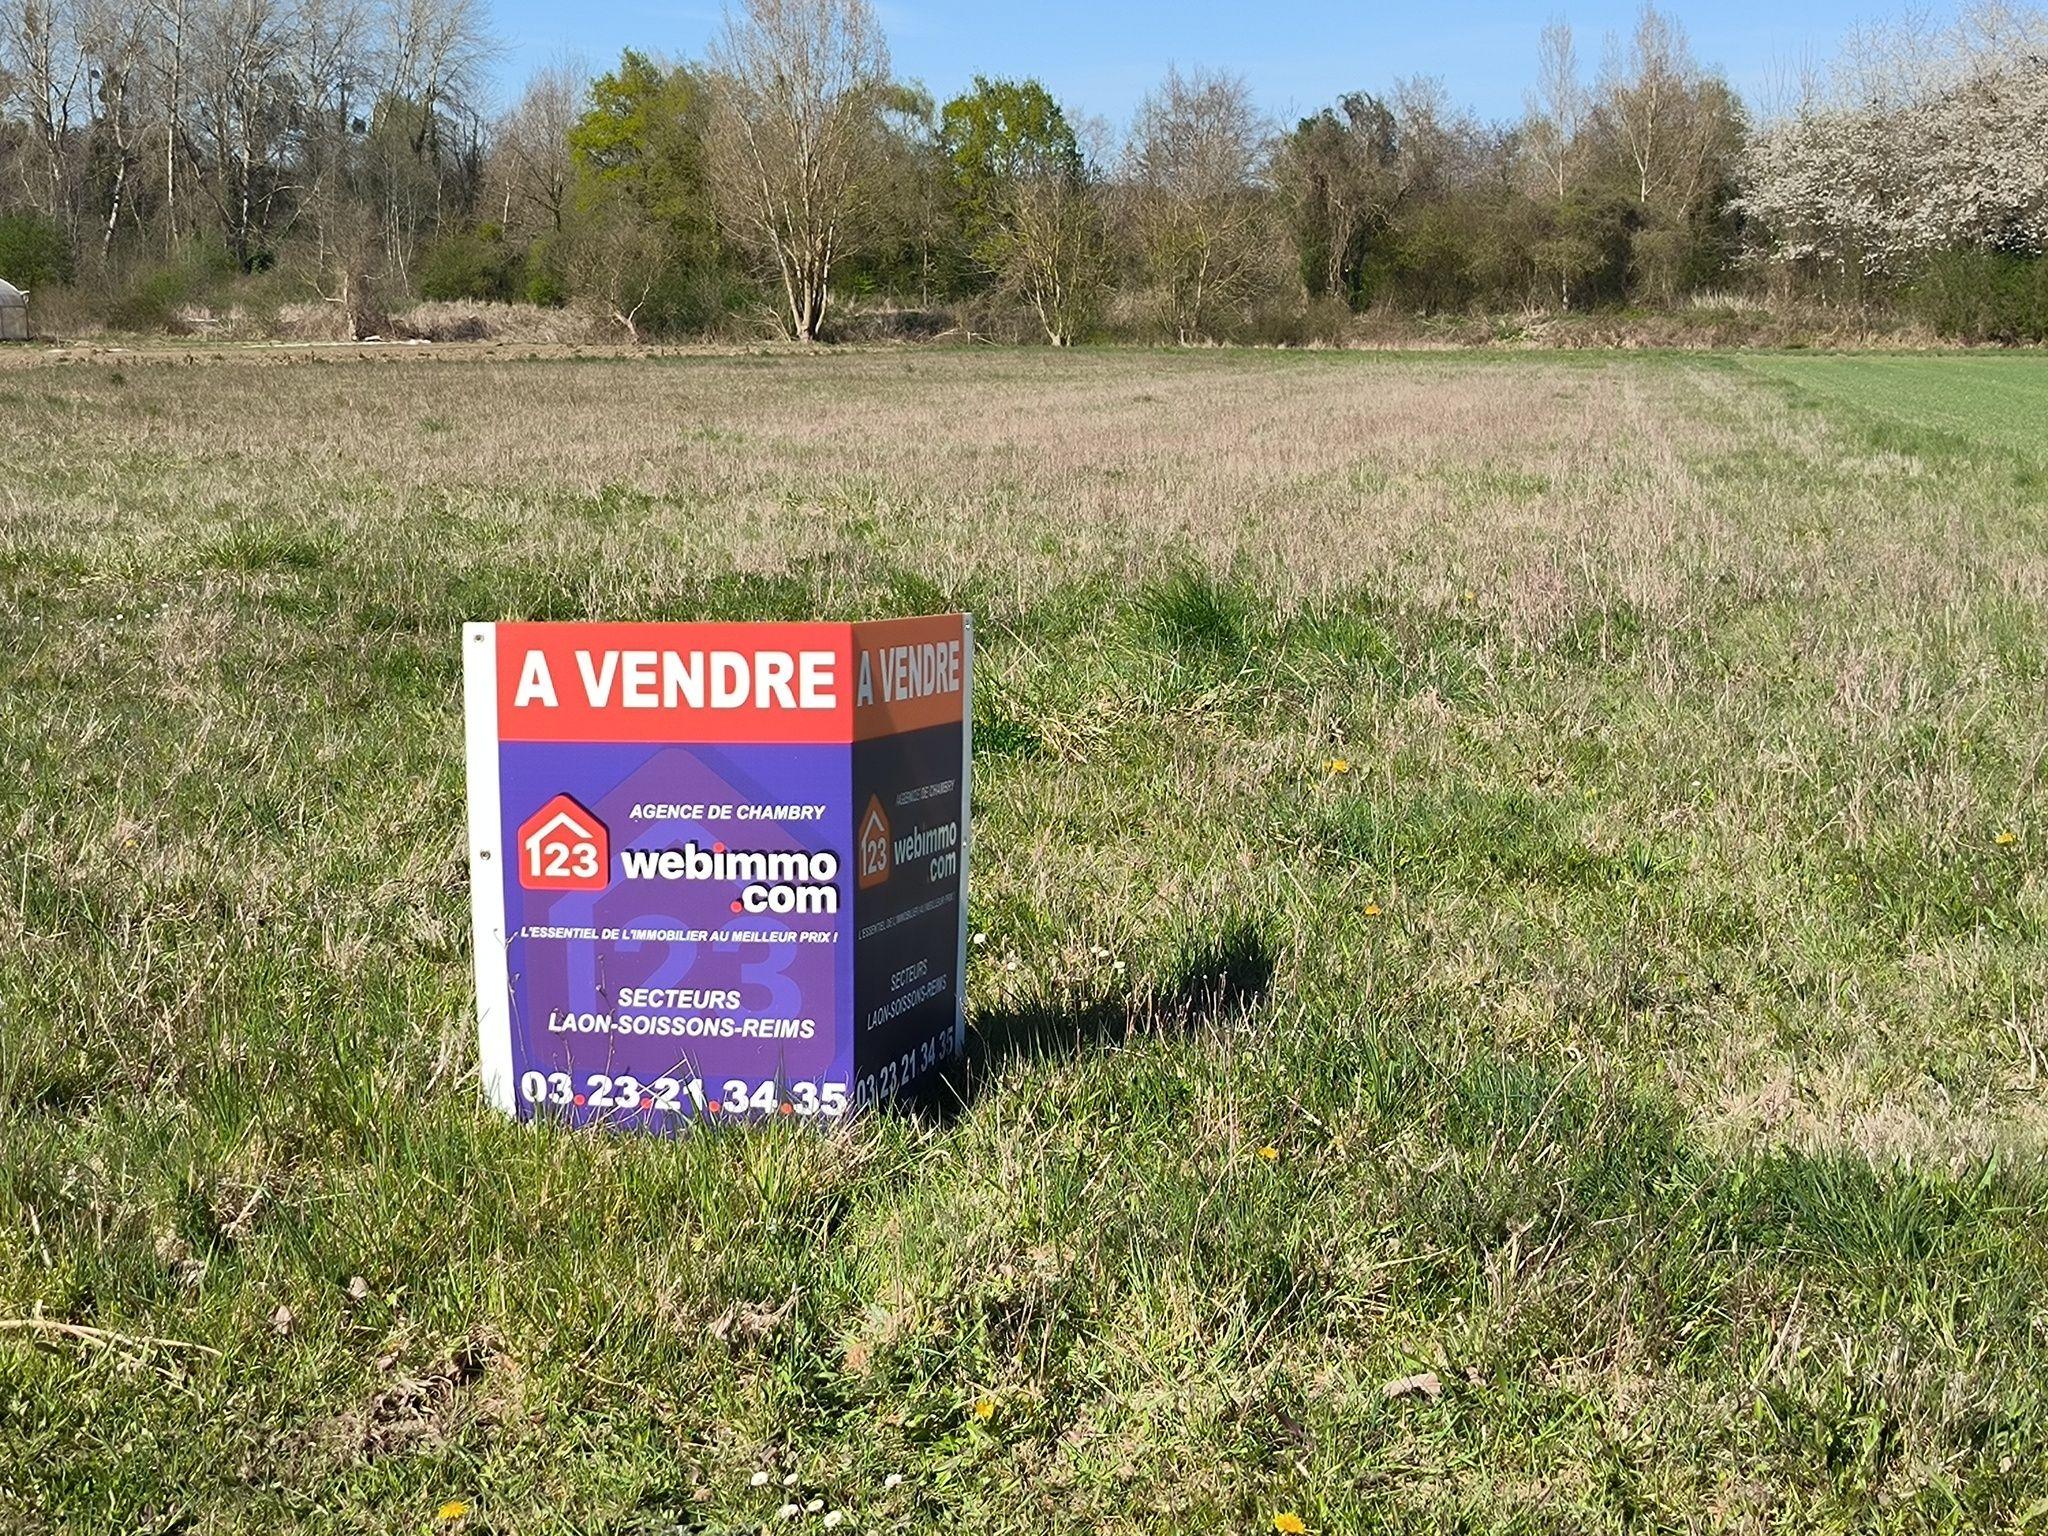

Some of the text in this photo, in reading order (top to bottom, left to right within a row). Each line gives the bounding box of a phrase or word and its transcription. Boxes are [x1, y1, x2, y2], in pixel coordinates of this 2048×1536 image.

[513, 650, 837, 709] A VENDRE
[857, 640, 960, 707] A VENDRE
[629, 804, 826, 820] AGENCE DE CHAMBRY
[525, 840, 600, 878] 123
[621, 842, 838, 881] webimmo
[862, 836, 888, 877] 123
[894, 821, 957, 865] webimmo
[730, 884, 838, 914] .com
[521, 927, 599, 940] L'ESSENTIEL
[602, 929, 620, 940] DE
[622, 929, 707, 941] L'IMMOBILIER
[709, 931, 729, 942] AU
[732, 931, 797, 942] MEILLEUR
[800, 932, 830, 943] PRIX
[891, 958, 929, 991] SECTEURS
[617, 988, 741, 1010] SECTEURS
[867, 973, 947, 1030] LAON-SOISSONS-REIMS
[549, 1013, 815, 1039] LAON-SOISSONS-REIMS
